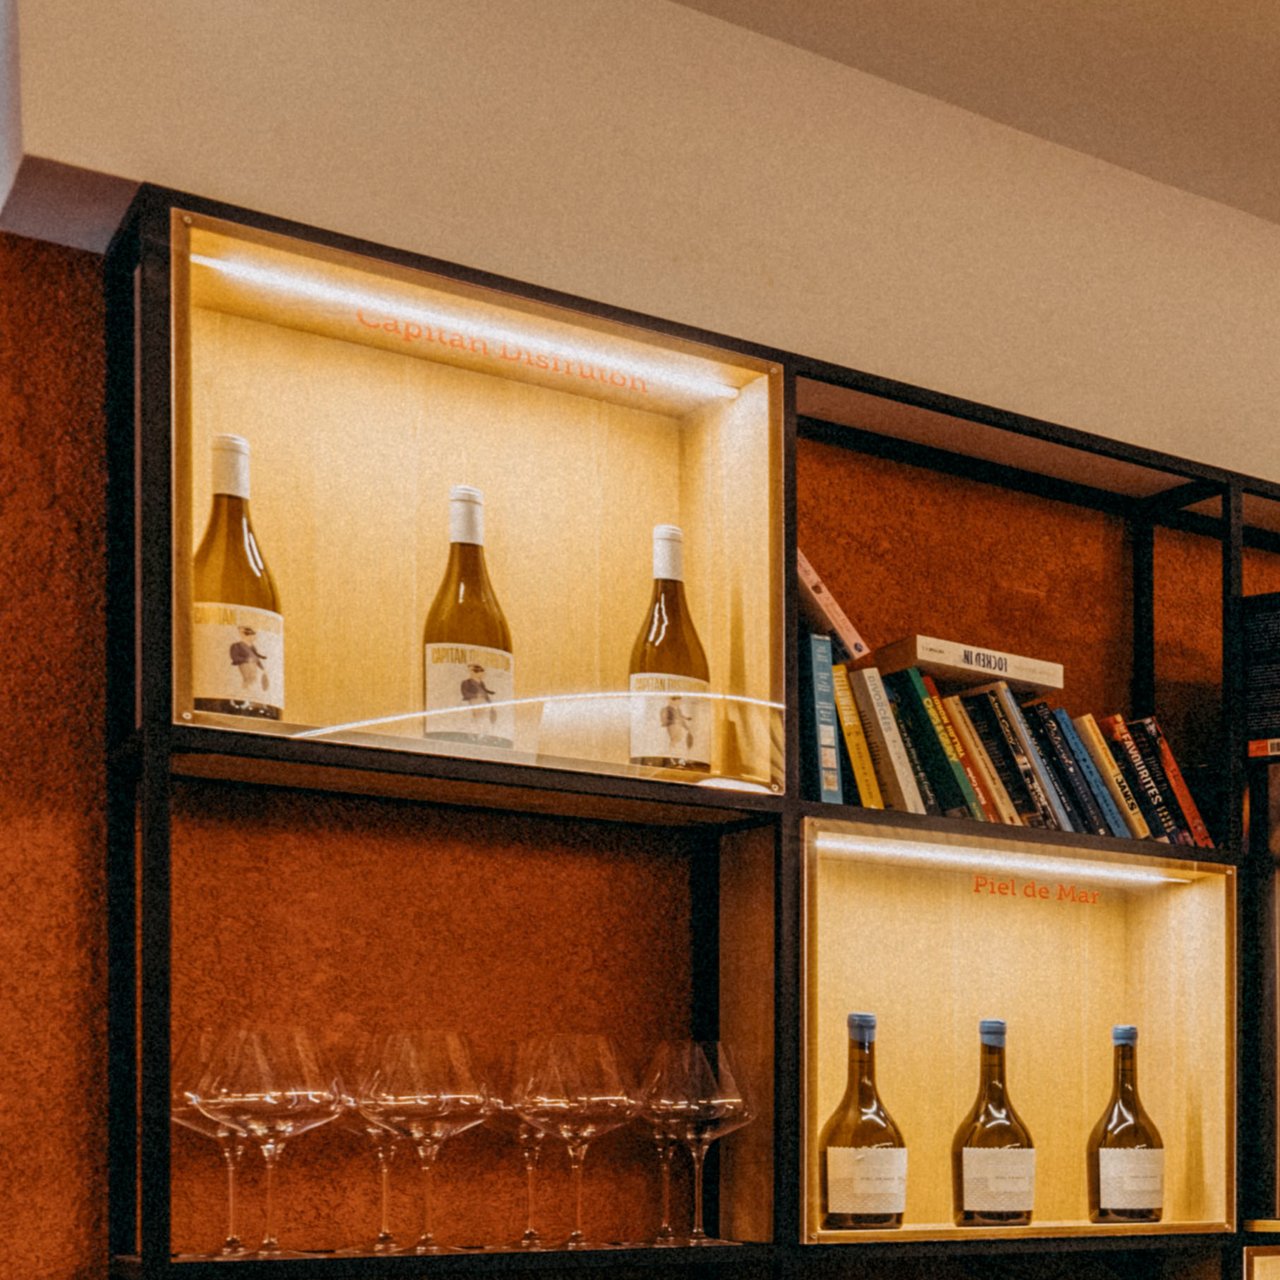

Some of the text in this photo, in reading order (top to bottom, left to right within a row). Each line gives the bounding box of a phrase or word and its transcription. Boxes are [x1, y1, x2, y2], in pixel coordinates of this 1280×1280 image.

[963, 649, 1008, 673] LOCKED IN
[1120, 731, 1163, 807] FAVOURITES
[1115, 776, 1138, 812] JAMES
[973, 875, 1100, 905] Piel de Mar
